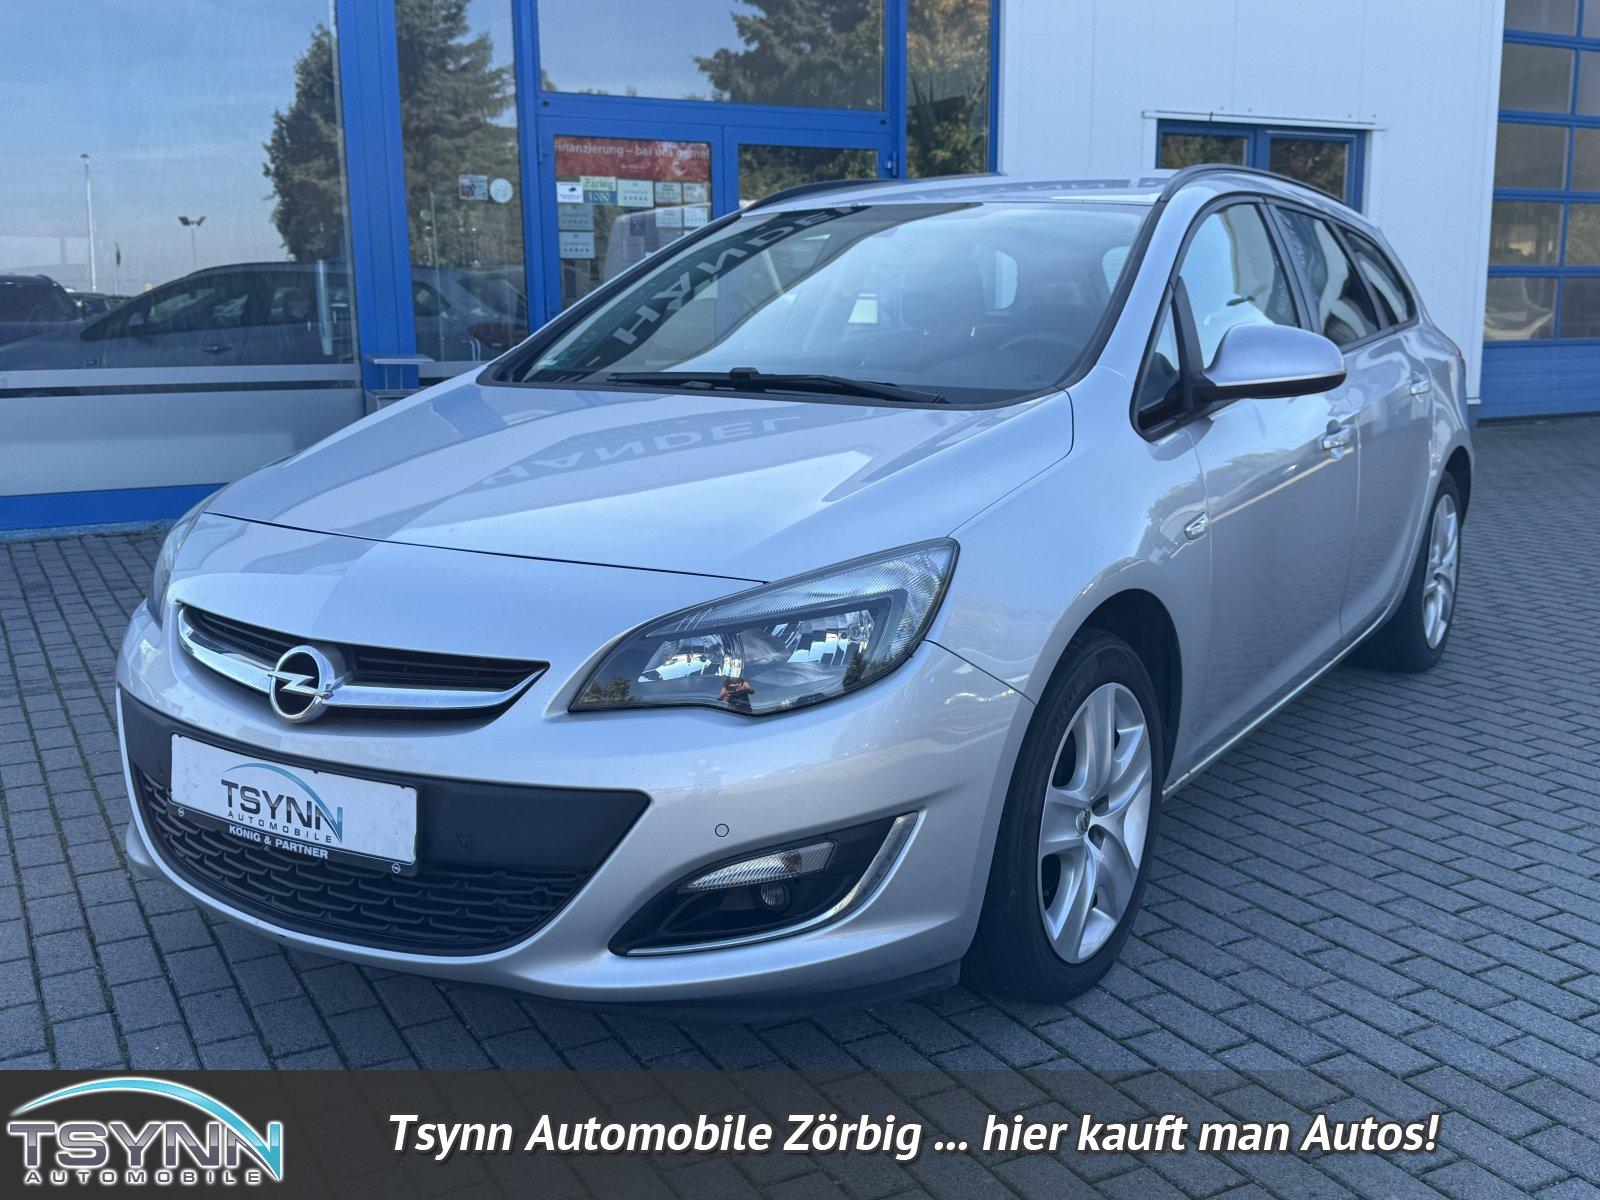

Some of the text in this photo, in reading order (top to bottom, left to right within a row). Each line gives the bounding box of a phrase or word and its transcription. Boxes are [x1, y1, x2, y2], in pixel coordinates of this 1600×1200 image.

[220, 778, 343, 844] TSYNN
[227, 810, 332, 844] AUTOMOBILE
[229, 824, 329, 860] KÖNIG & PARTNER
